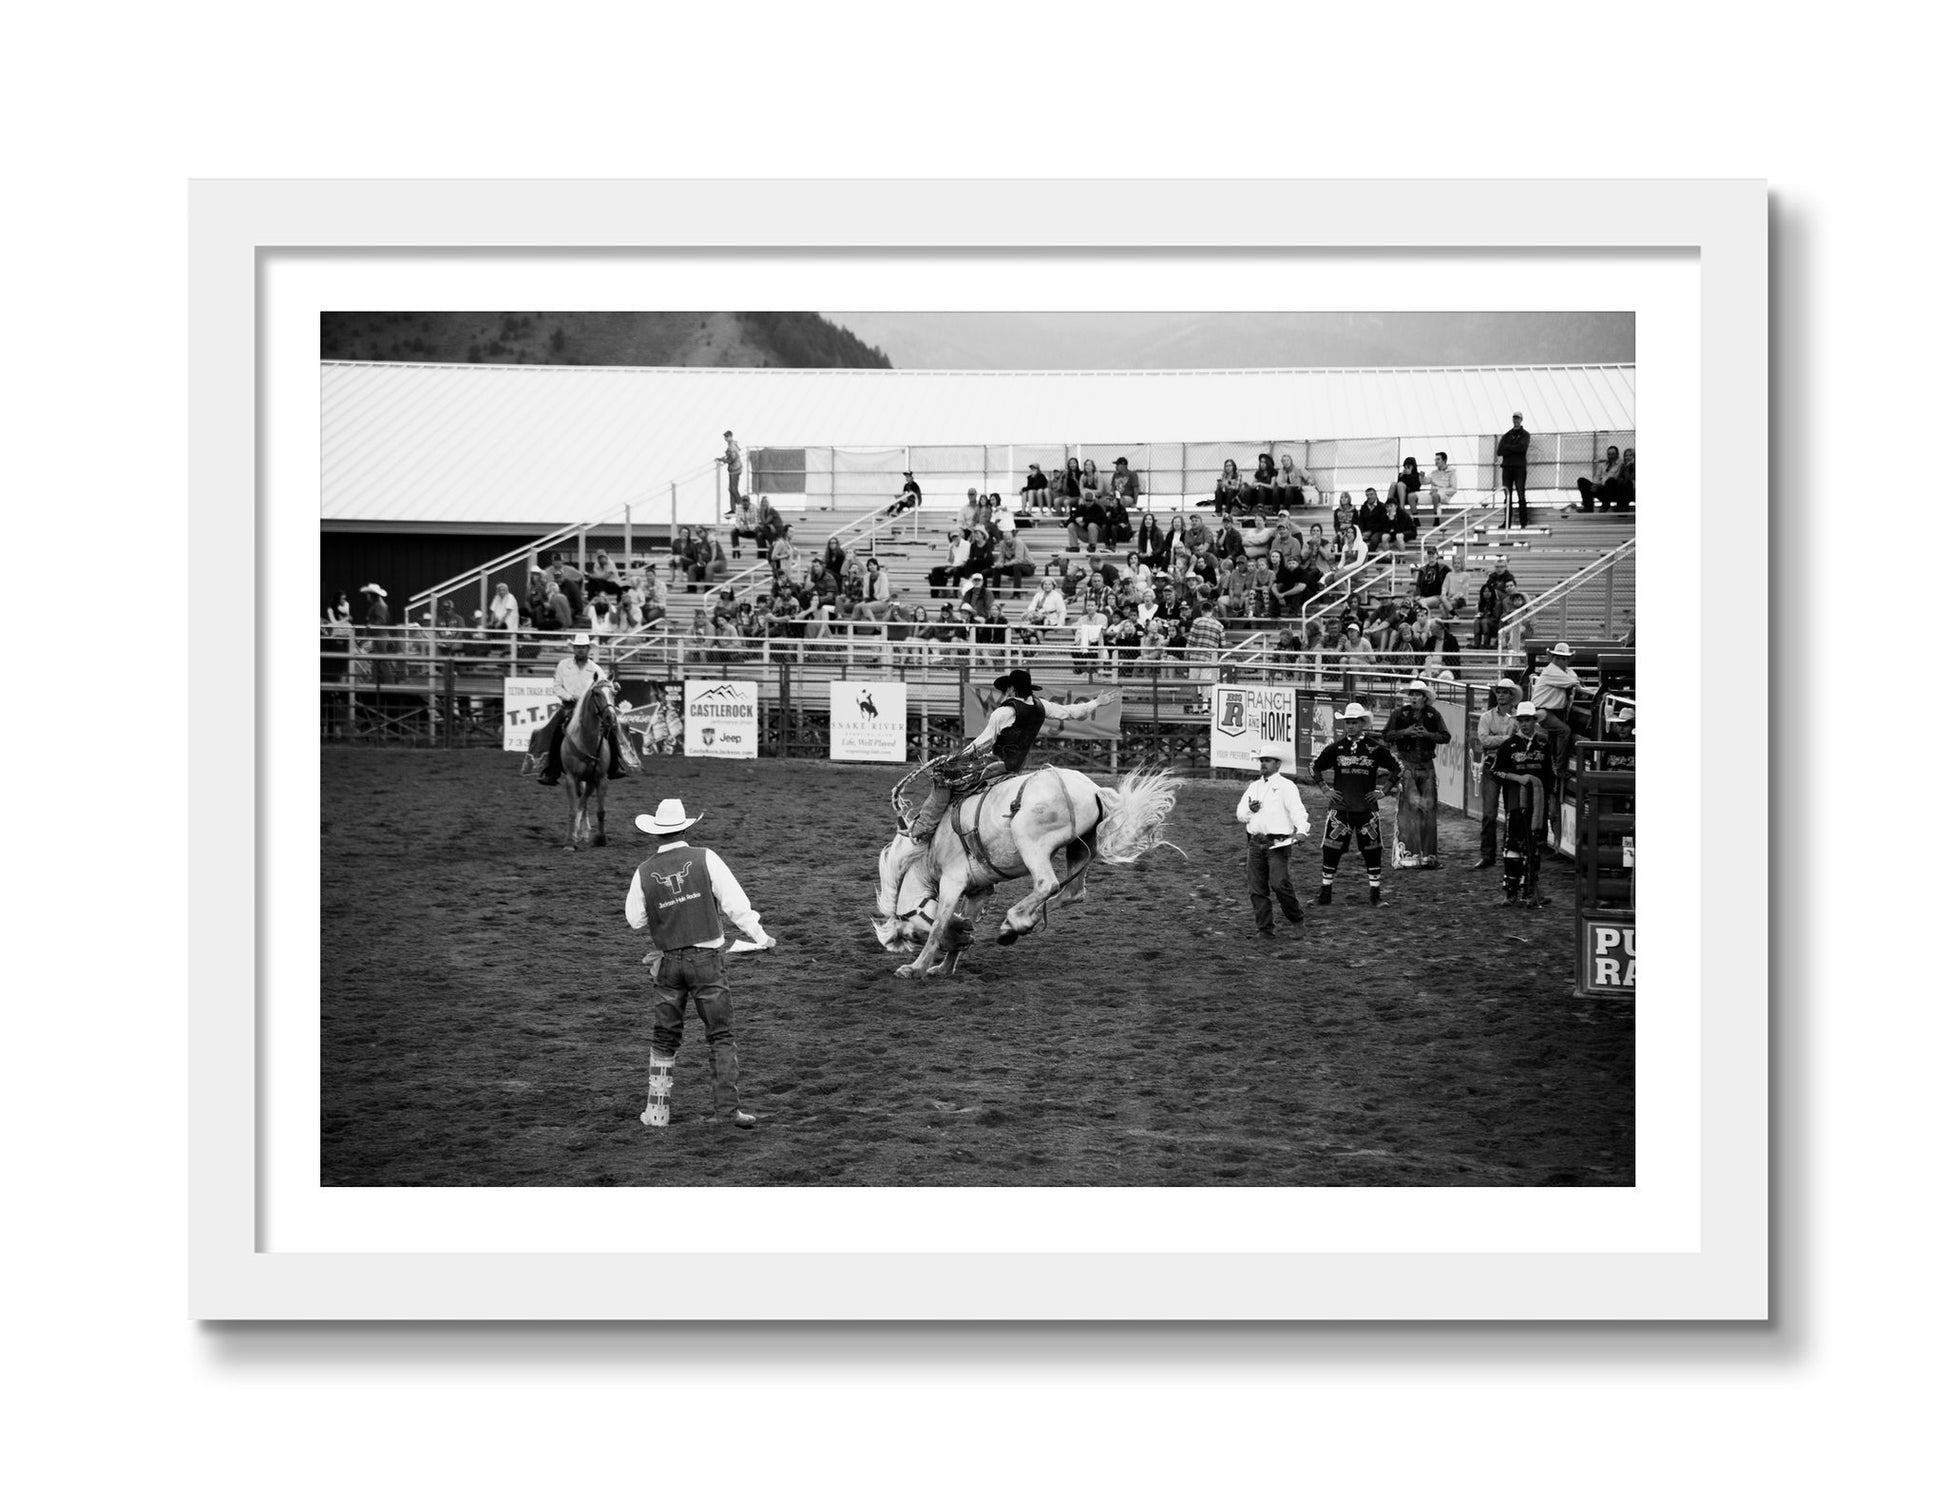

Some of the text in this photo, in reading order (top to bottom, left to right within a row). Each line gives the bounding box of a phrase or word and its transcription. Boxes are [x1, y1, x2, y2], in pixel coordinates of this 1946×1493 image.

[1247, 690, 1292, 711] RANCH
[690, 704, 753, 718] CASTLEROCK
[1221, 702, 1244, 727] R
[832, 722, 904, 731] SNAKE RIVER
[1261, 711, 1292, 742] HOME
[719, 733, 742, 744] Jeep
